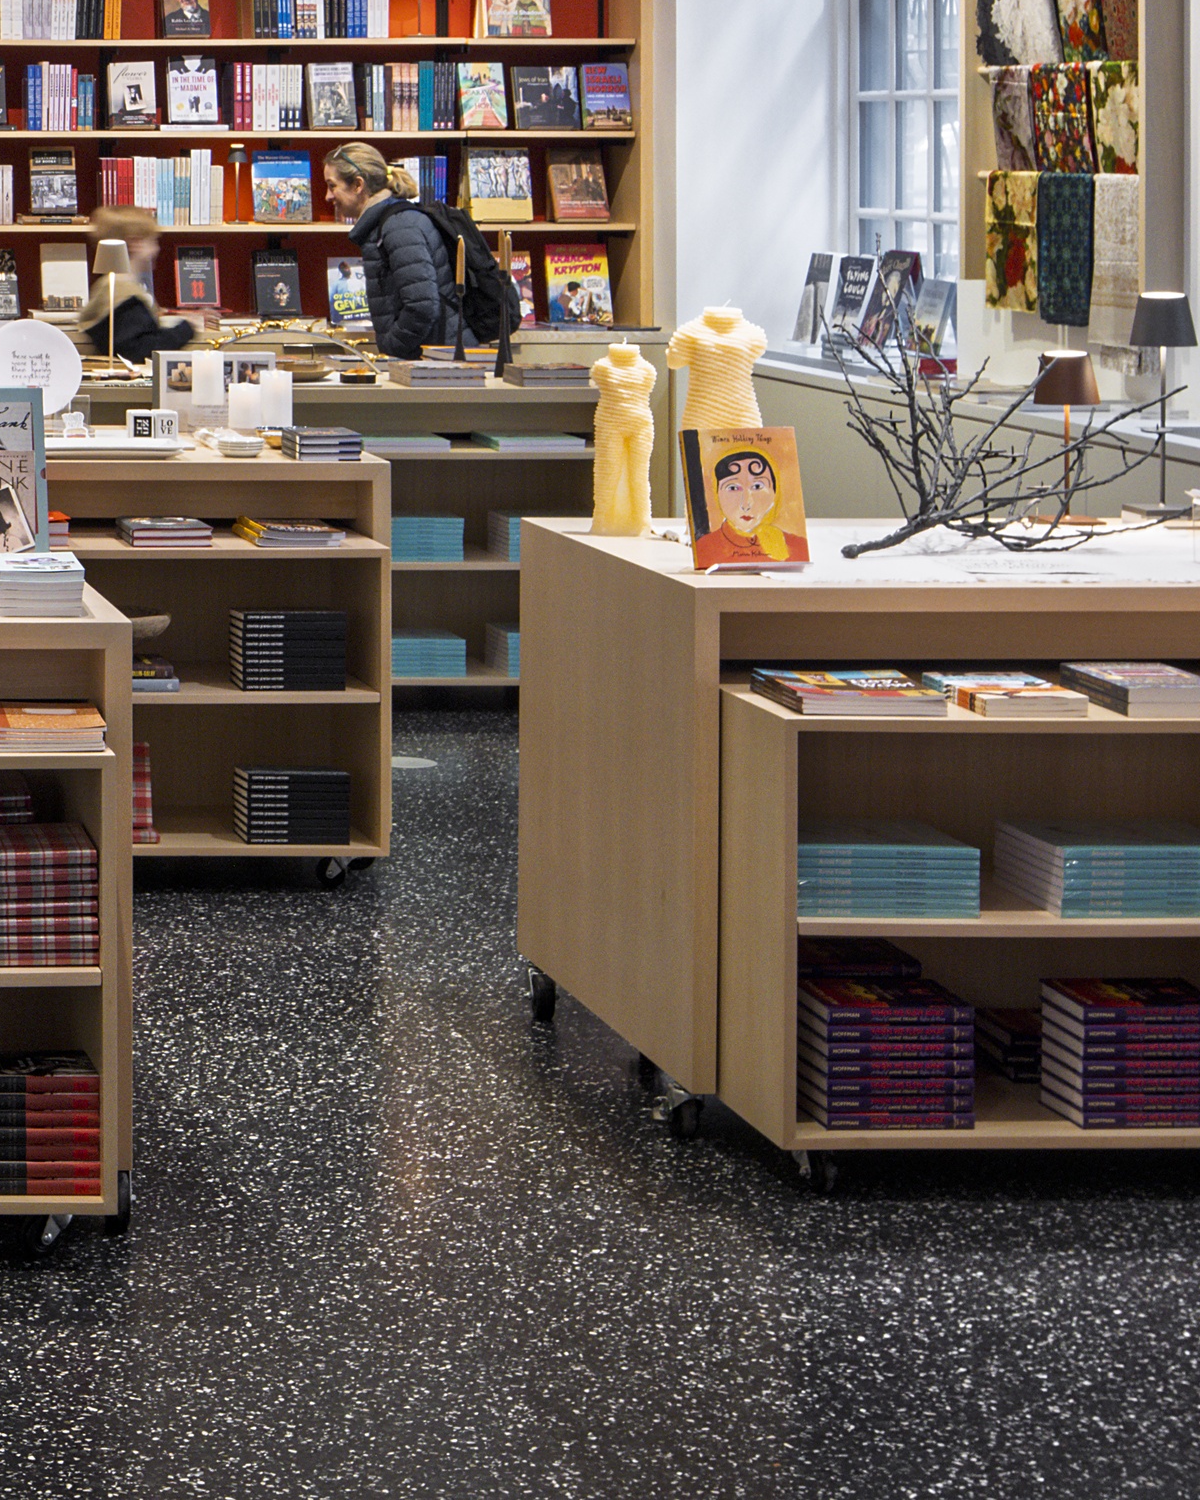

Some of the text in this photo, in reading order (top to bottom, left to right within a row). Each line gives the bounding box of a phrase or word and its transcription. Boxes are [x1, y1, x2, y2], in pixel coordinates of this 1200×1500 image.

[585, 66, 607, 74] NEW
[586, 76, 622, 84] ISRAELI
[587, 85, 626, 93] HORROR
[550, 254, 594, 264] KRAKOW
[554, 263, 602, 275] KRYPTON
[846, 270, 869, 282] FLYING
[333, 298, 368, 311] GEVAL
[12, 351, 27, 359] There
[31, 366, 52, 375] having
[732, 434, 754, 444] Holding
[755, 434, 772, 444] Things
